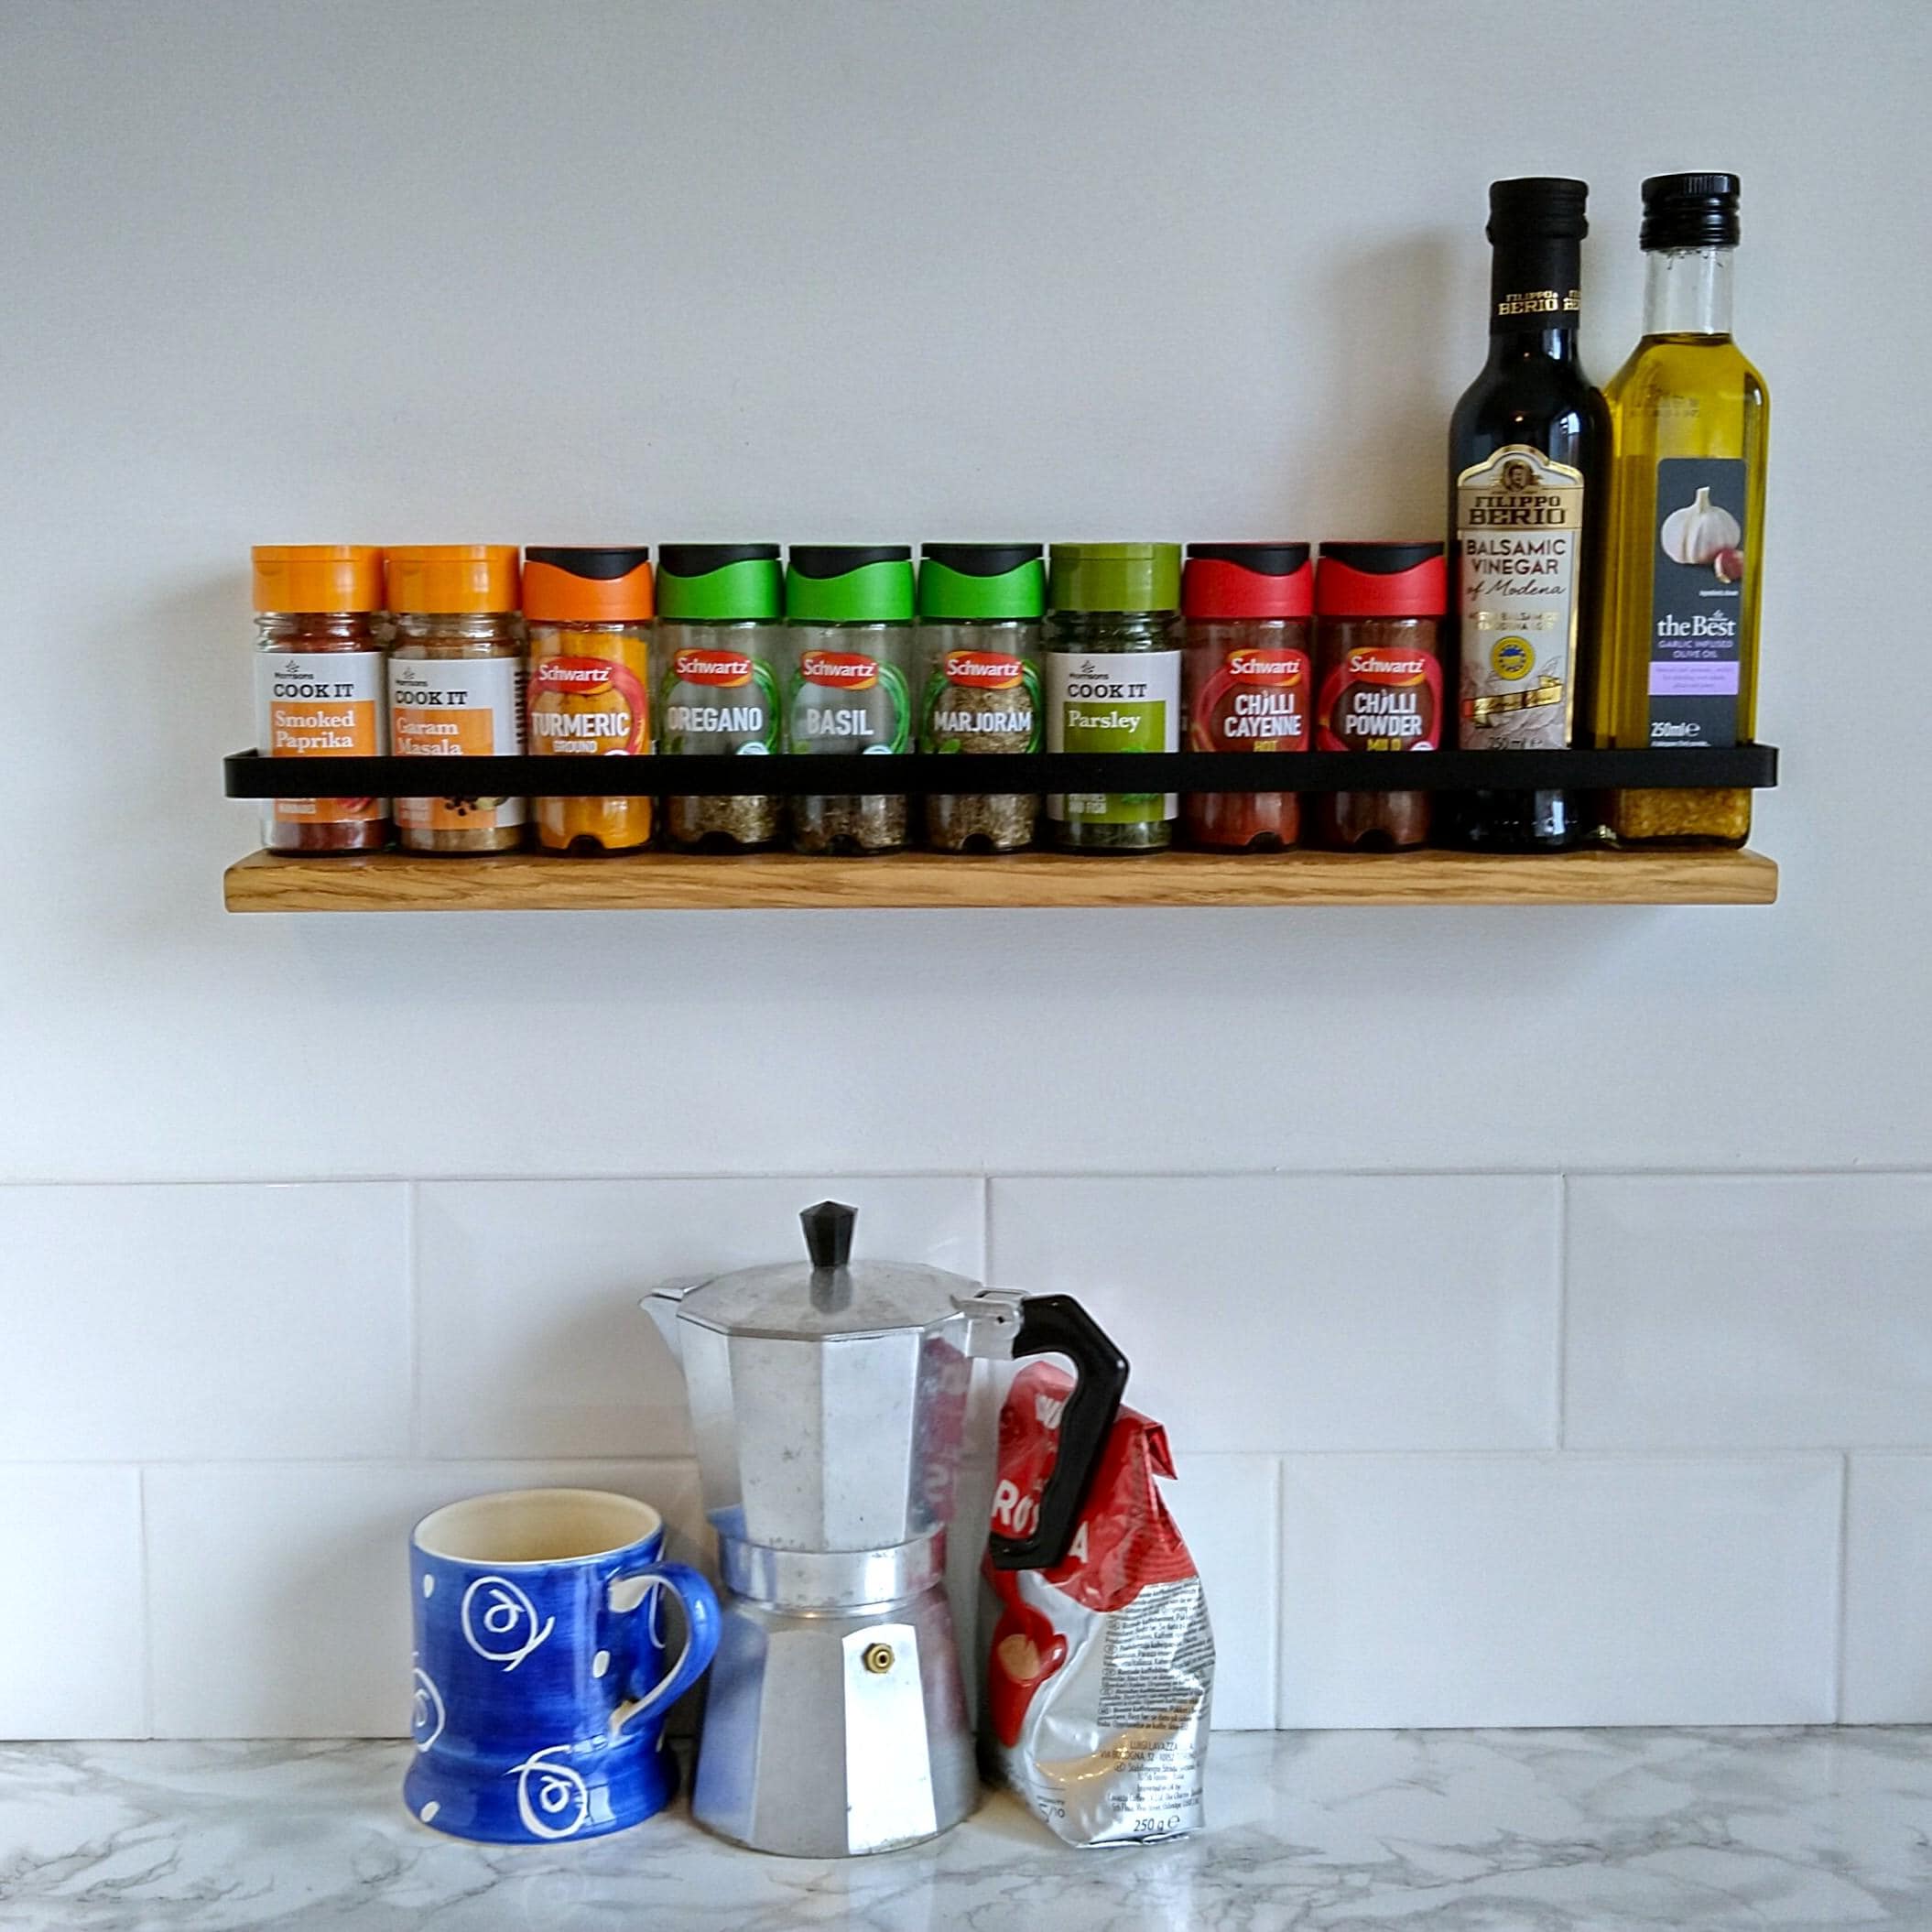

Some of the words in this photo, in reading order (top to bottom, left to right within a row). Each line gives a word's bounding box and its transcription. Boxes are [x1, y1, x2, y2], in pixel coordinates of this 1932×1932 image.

[1498, 298, 1558, 316] BERIO
[1475, 495, 1561, 508] FILIPPO
[1469, 508, 1567, 526] BERIO
[1467, 539, 1567, 556] BALSAMIC
[1471, 559, 1559, 575] VINEGAR
[1467, 581, 1485, 601] of
[1484, 579, 1567, 597] Modena
[1657, 613, 1691, 636] the
[1691, 615, 1737, 636] Best
[538, 664, 612, 682] Schwartz
[676, 657, 751, 675] Schwartz
[803, 659, 877, 678] Schwartz
[947, 658, 1022, 677] Schwartz
[1230, 657, 1301, 674] Schwartz
[1349, 656, 1426, 673] Schwartz
[274, 683, 331, 698] COOK
[333, 683, 354, 698] IT
[396, 690, 443, 705] COOK
[446, 690, 469, 705] IT
[1068, 684, 1123, 698] COOK
[1127, 684, 1147, 698] IT
[276, 710, 355, 728] Smoked
[396, 717, 460, 735] Garam
[531, 711, 631, 737] TURMERIC
[668, 707, 763, 732] OREGANO
[806, 709, 874, 736] BASIL
[933, 711, 1032, 733] MARJORAM
[1068, 710, 1142, 733] Parsley
[1223, 715, 1302, 738] CAYENNE
[1344, 714, 1423, 736] POWDER
[277, 731, 354, 754] Paprika
[396, 737, 464, 755] Masala
[1134, 1818, 1155, 1832] 250
[1156, 1819, 1166, 1832] g
